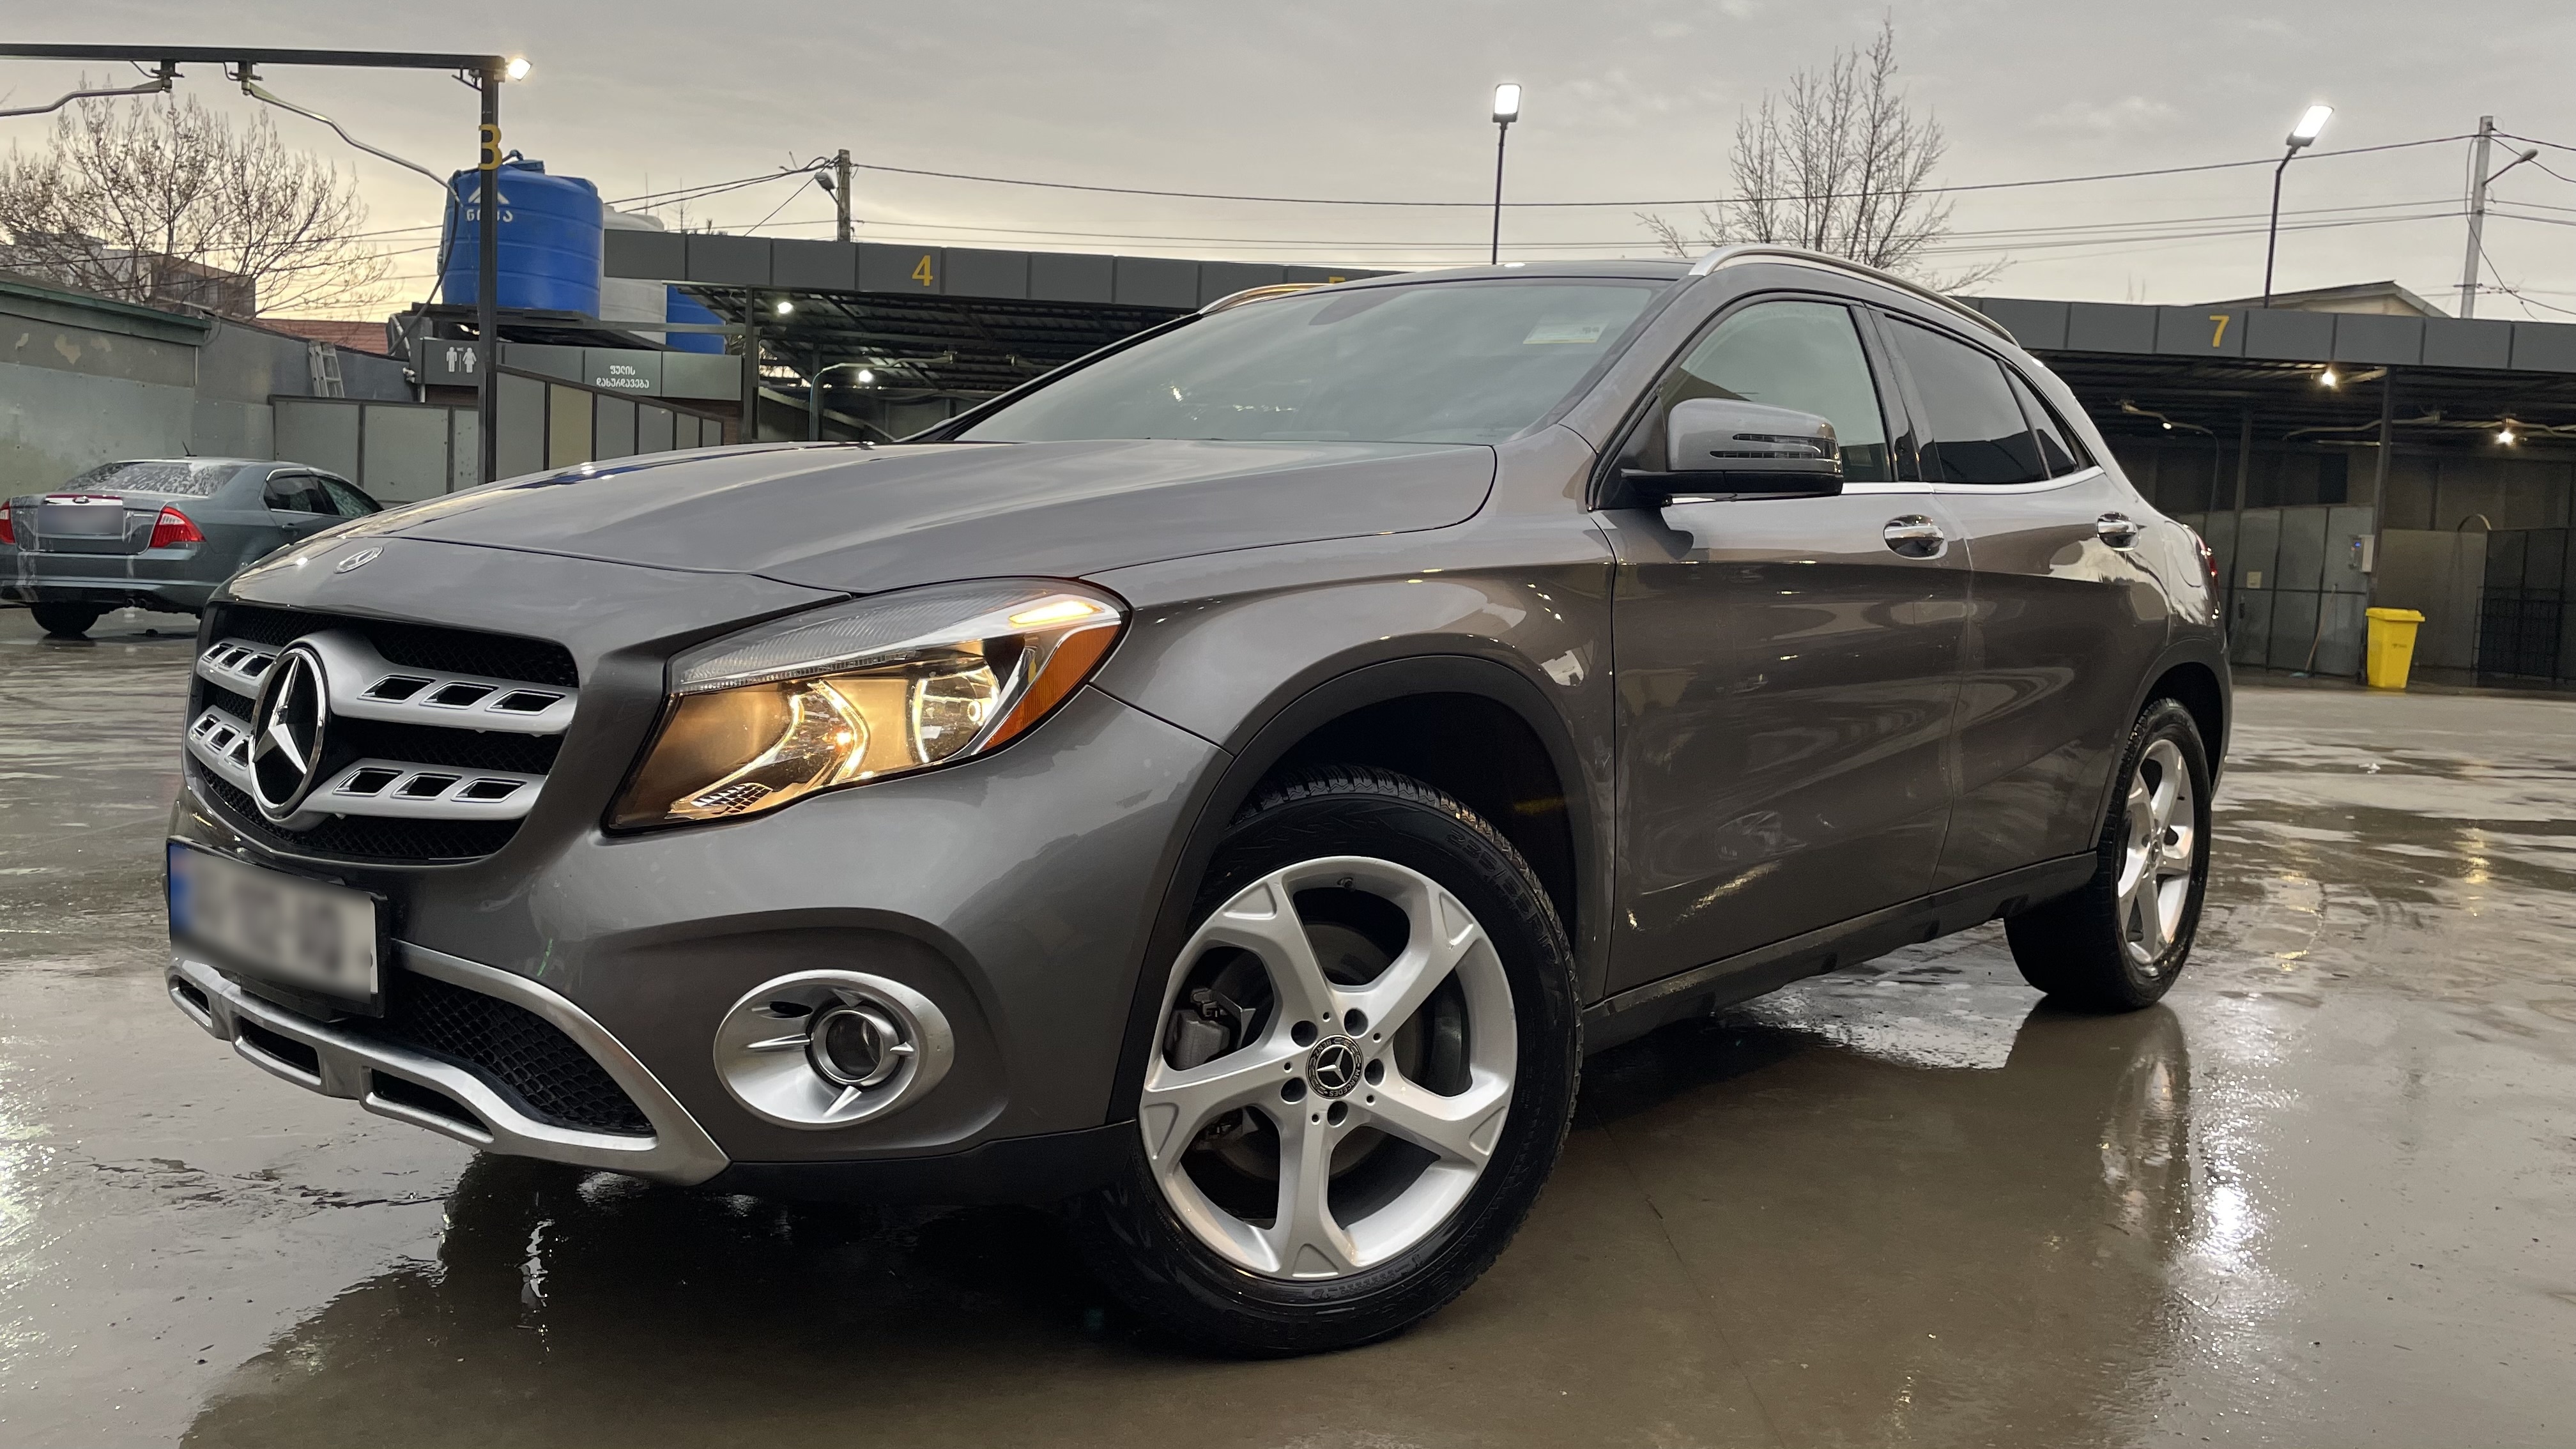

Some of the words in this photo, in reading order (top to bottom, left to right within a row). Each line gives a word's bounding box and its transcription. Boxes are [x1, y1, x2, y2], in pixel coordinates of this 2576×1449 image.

[479, 124, 502, 170] 3
[466, 209, 513, 222] ნა
[912, 255, 933, 286] 4
[2209, 315, 2230, 348] 7
[610, 365, 636, 376] ფულის
[596, 377, 650, 389] დახურდავება
[1314, 1039, 1332, 1057] BENZ
[1329, 1069, 1361, 1097] MERCEDES
